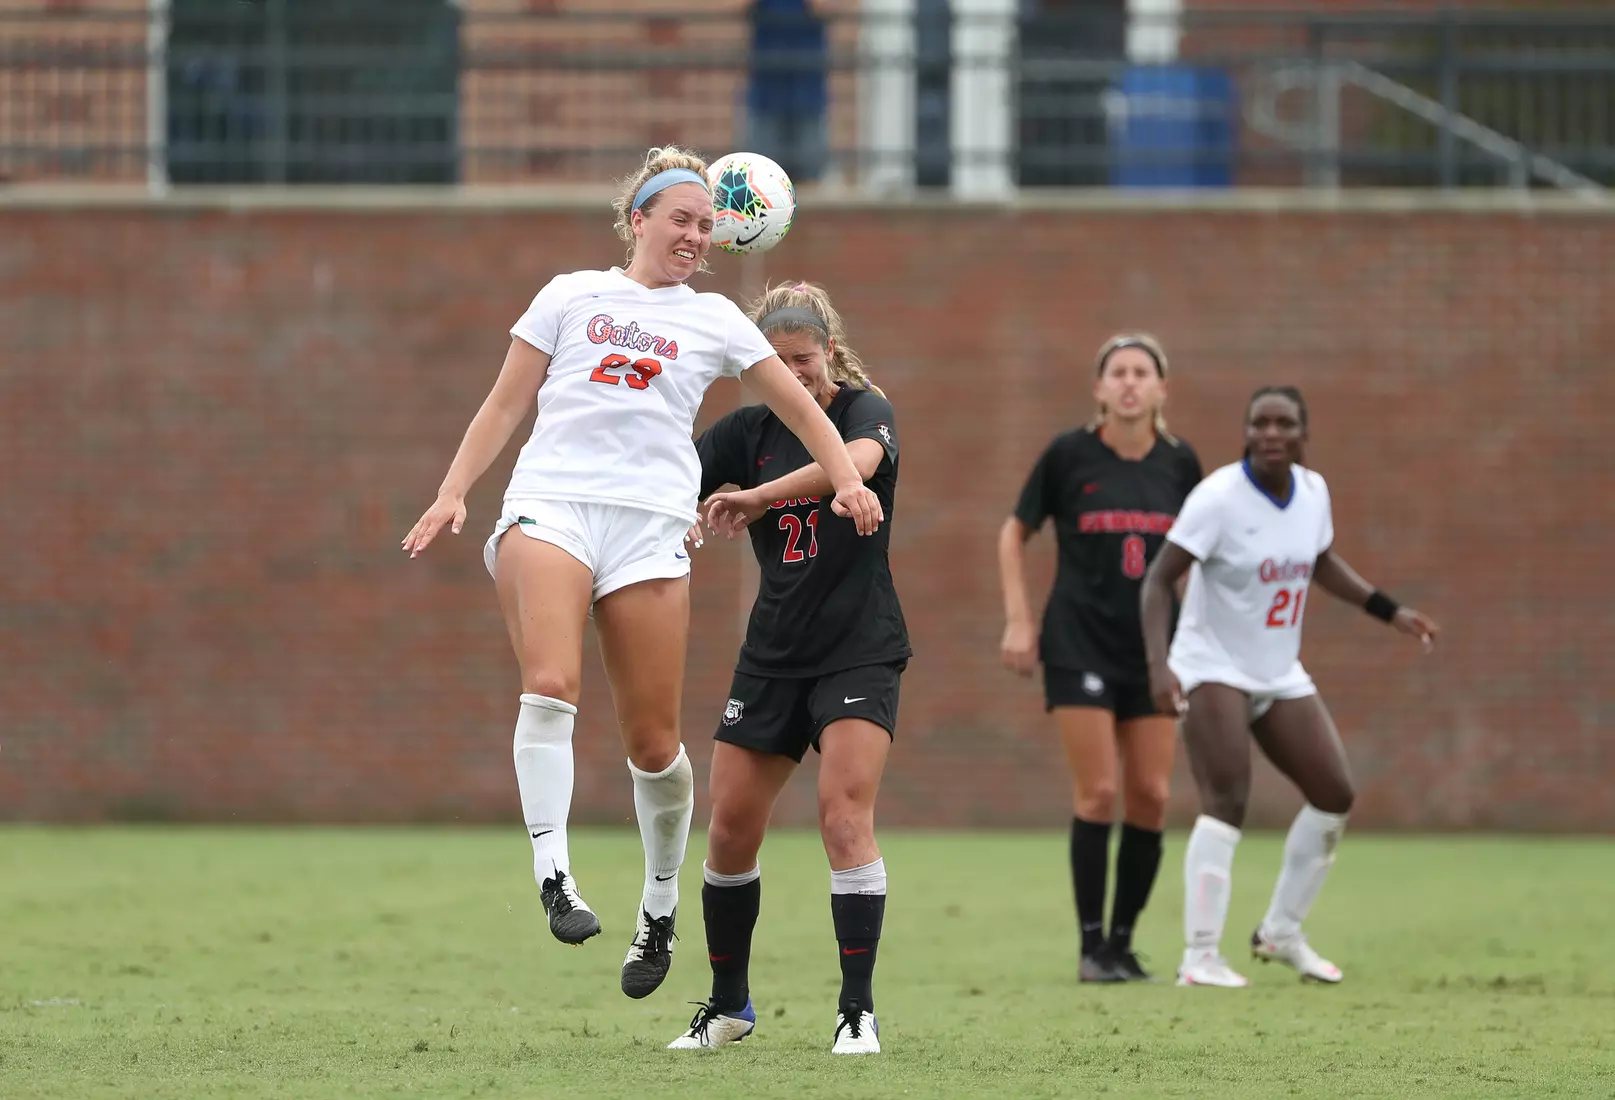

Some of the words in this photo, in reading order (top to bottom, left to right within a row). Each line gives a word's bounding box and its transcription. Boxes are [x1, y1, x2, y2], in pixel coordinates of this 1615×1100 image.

[587, 314, 678, 360] Gators
[589, 353, 662, 390] 23
[1264, 587, 1304, 627] 21
